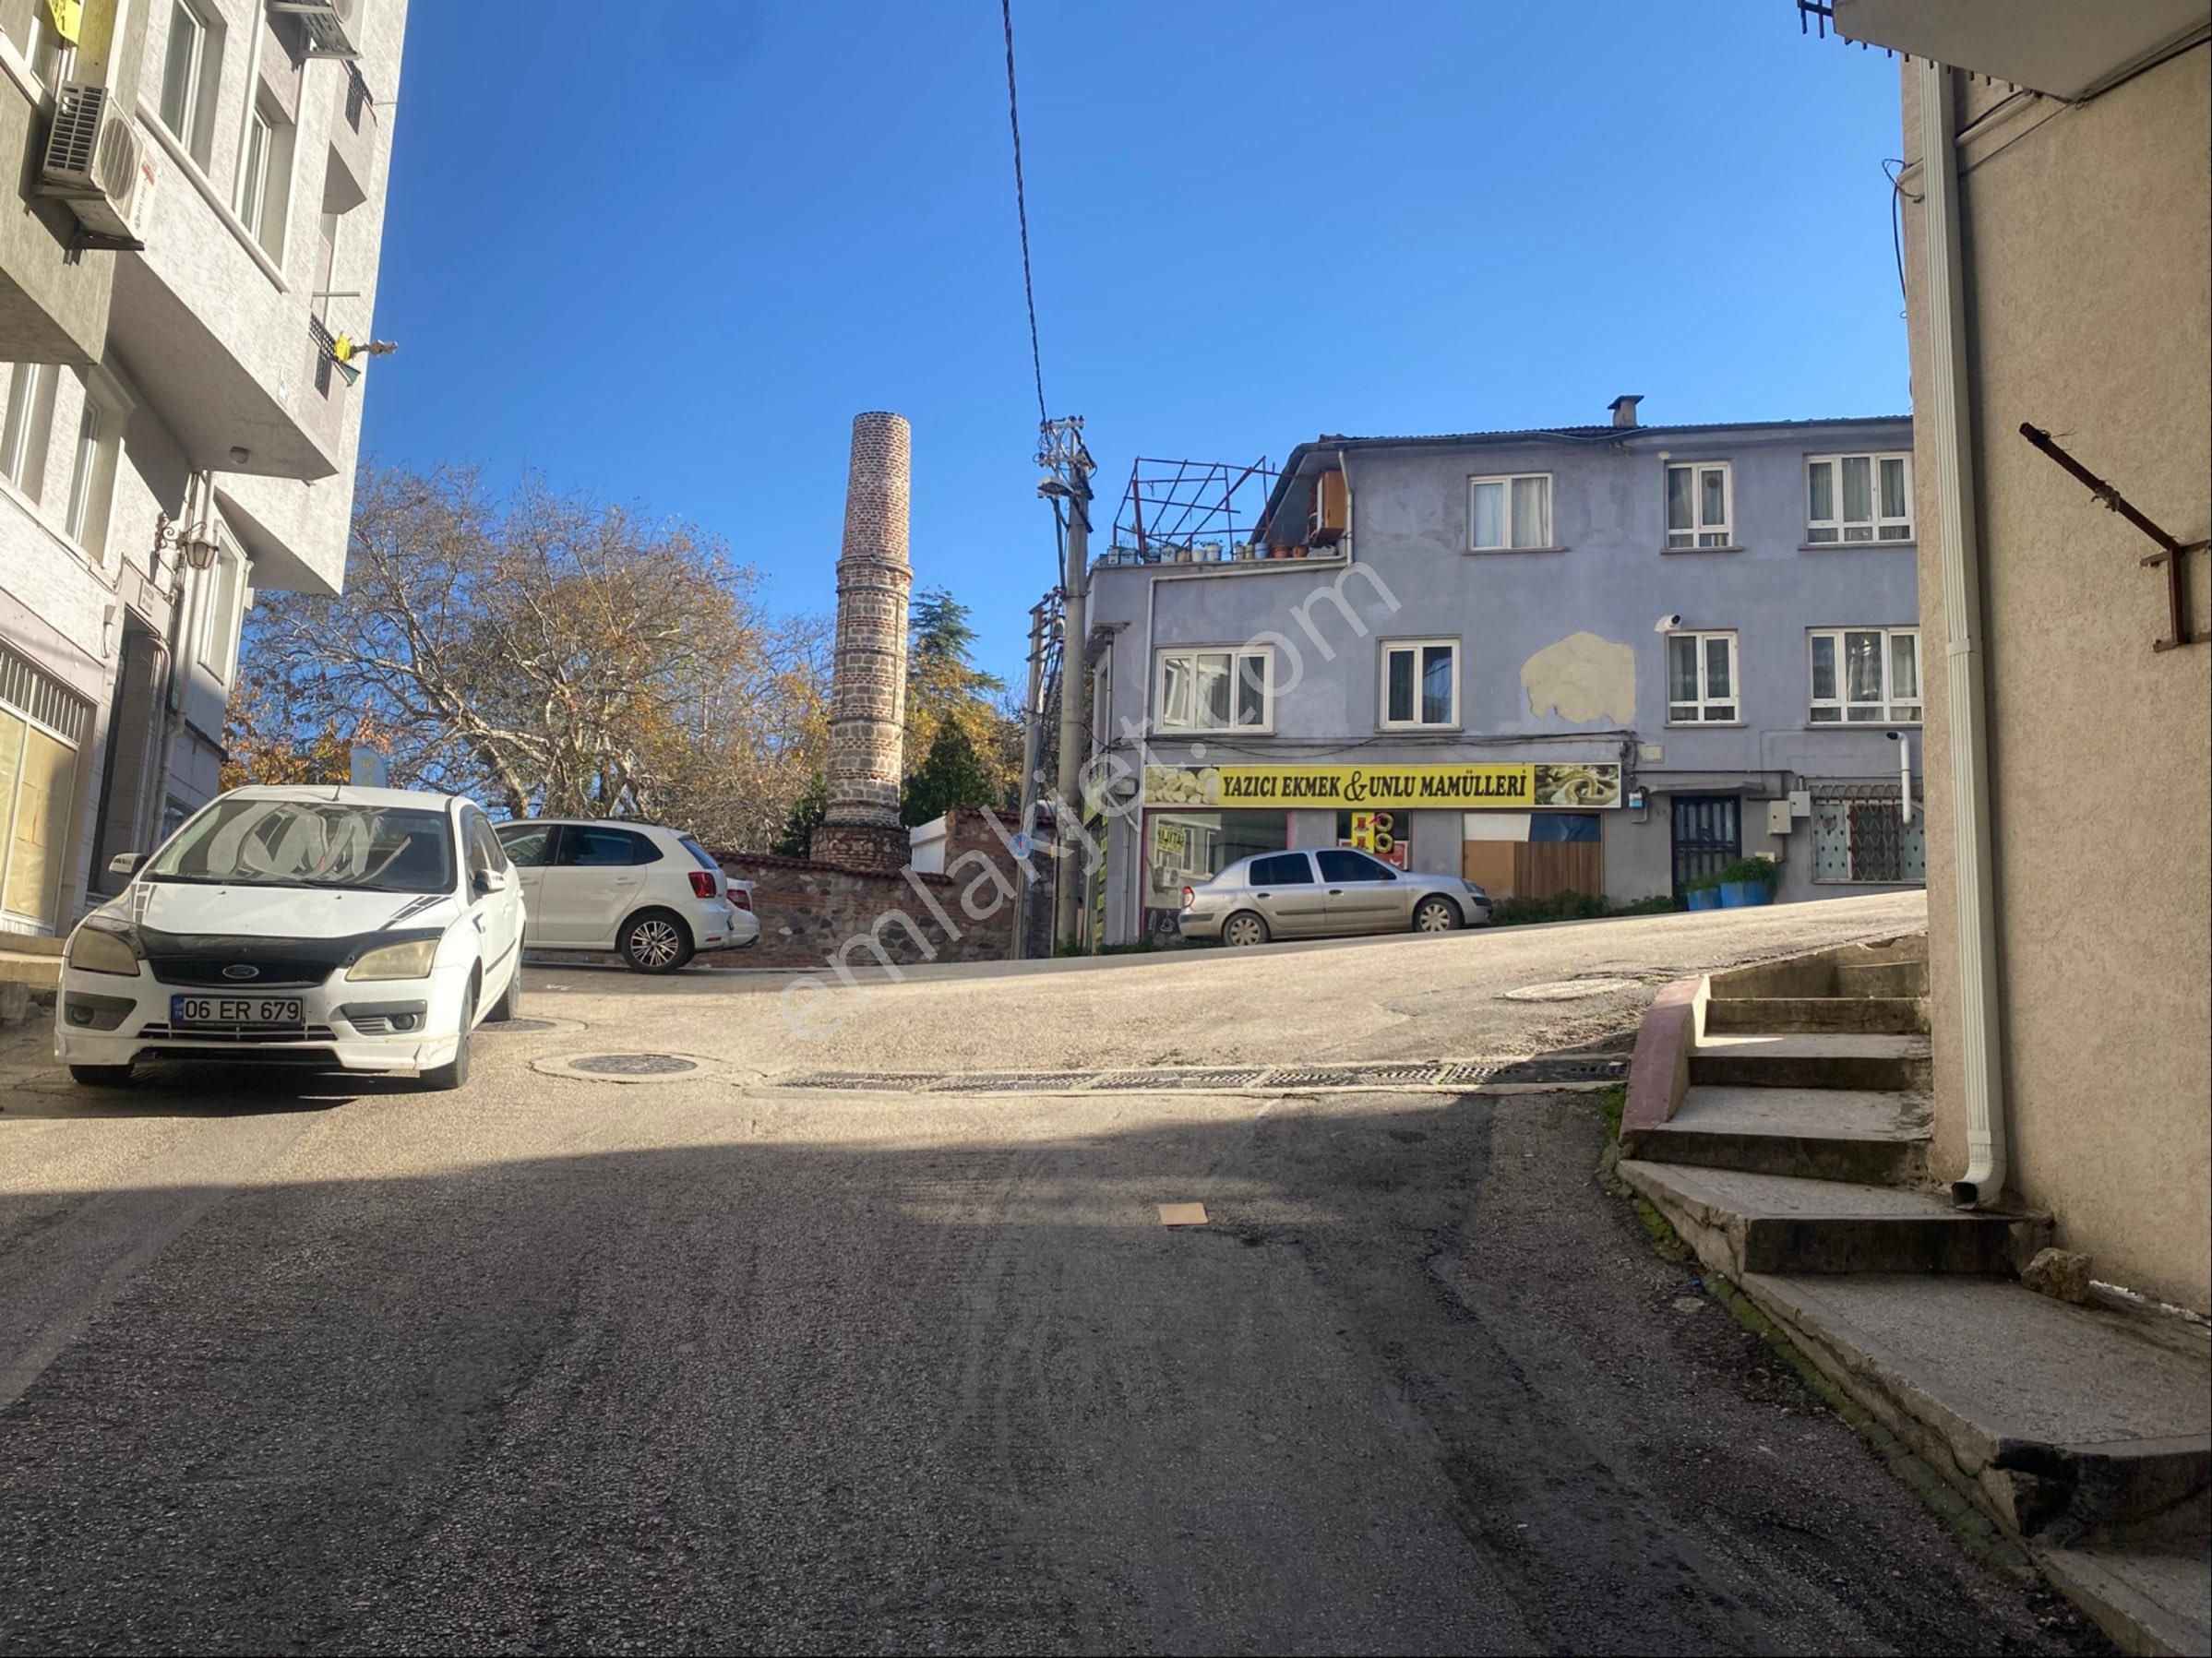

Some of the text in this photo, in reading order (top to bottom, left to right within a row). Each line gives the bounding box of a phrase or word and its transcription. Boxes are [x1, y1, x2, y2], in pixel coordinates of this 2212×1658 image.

[1223, 769, 1526, 802] YAZICI EKMEK & UNLU MAMÜLLERİ
[185, 1000, 299, 1020] 06 ER 679
